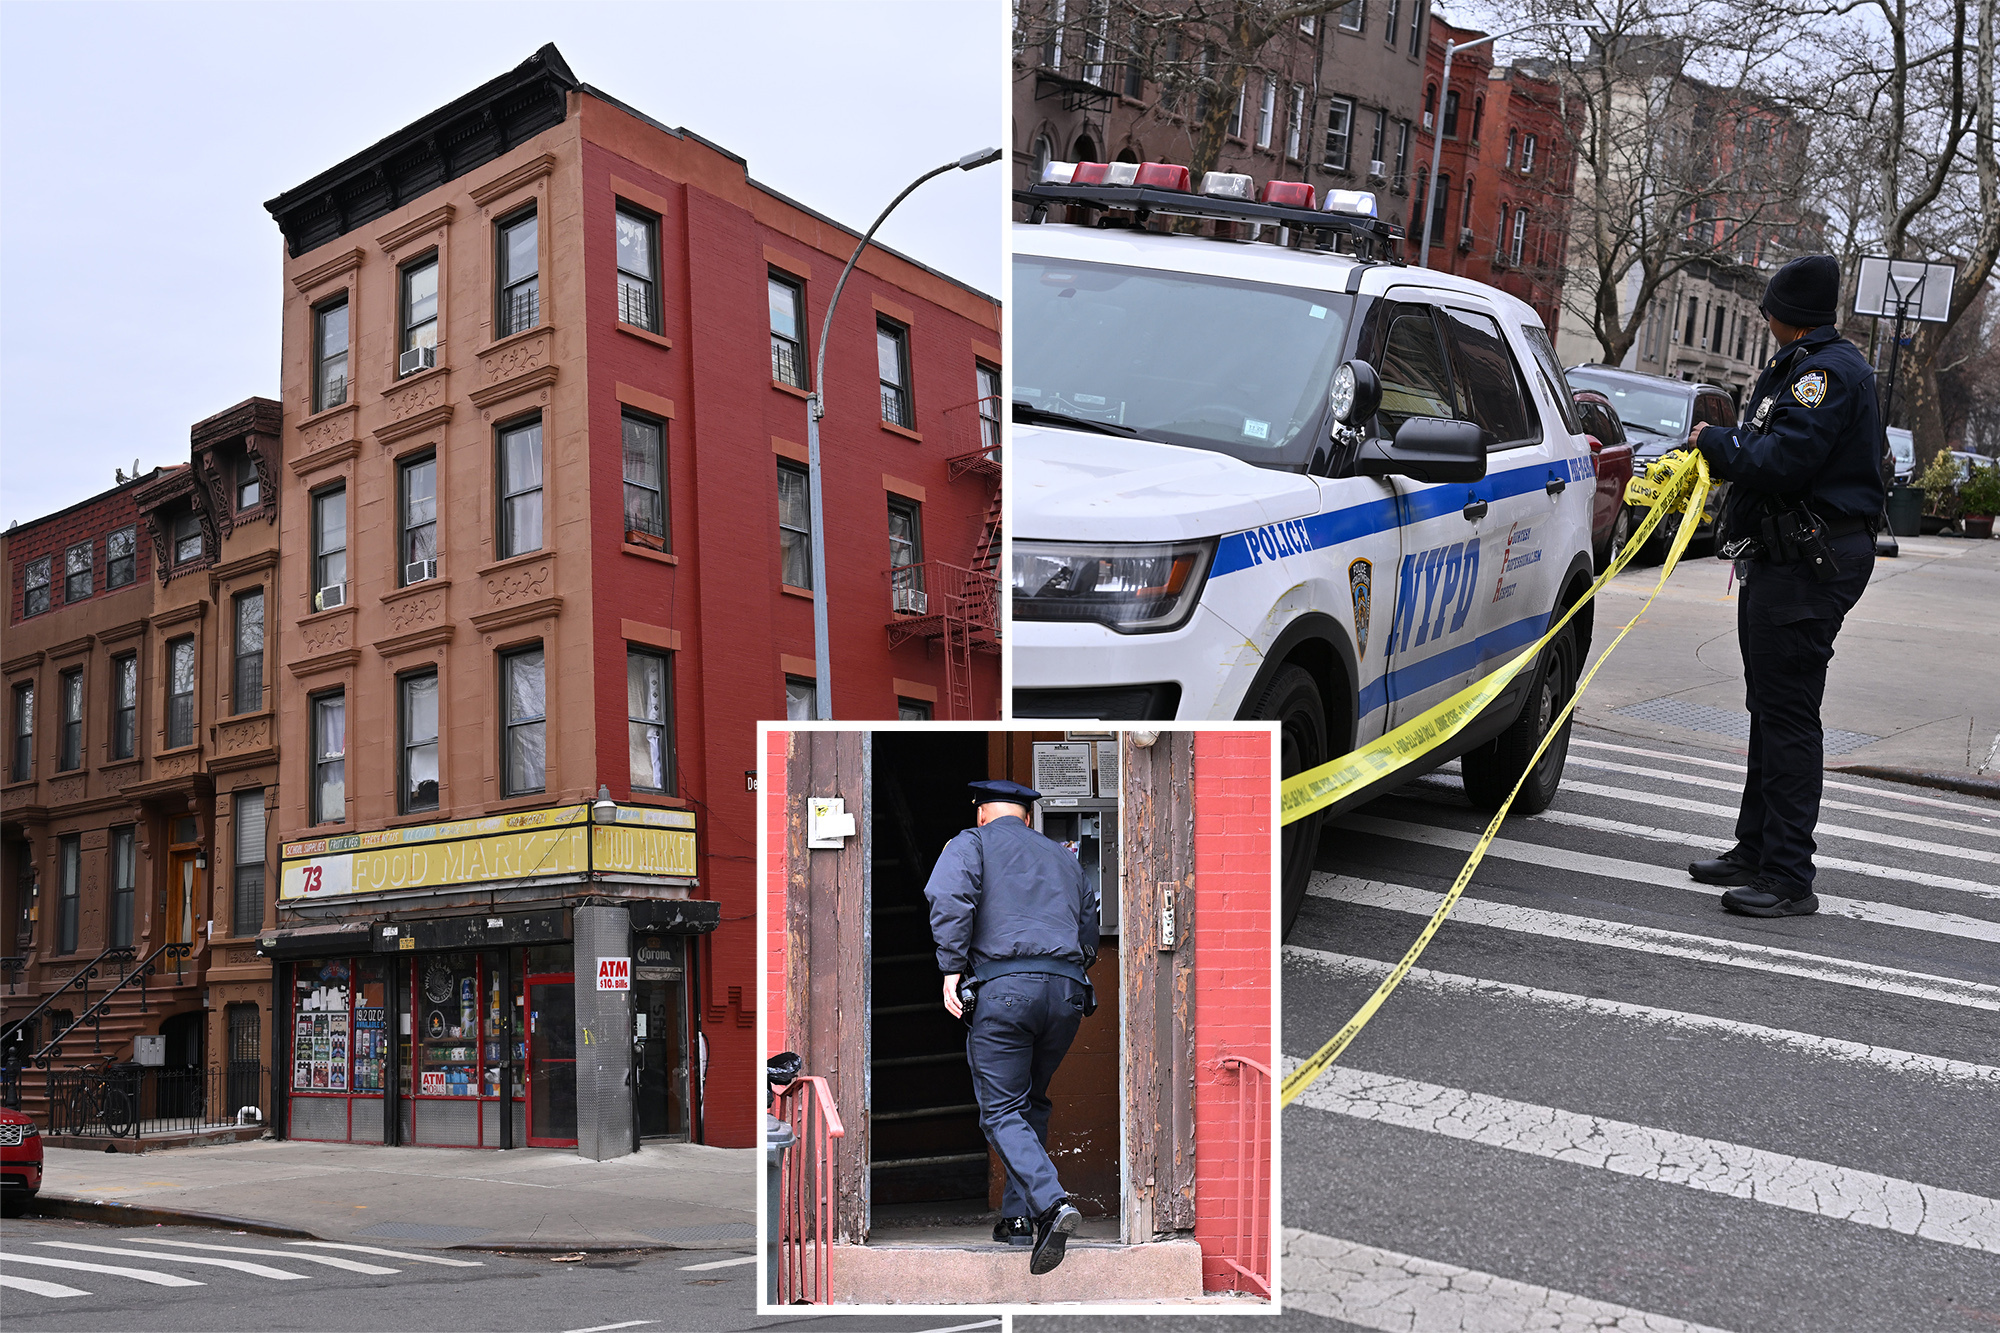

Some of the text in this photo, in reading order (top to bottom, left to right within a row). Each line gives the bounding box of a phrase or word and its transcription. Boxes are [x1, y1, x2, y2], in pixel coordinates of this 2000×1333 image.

[1245, 519, 1312, 566] POLICE
[1508, 521, 1532, 546] COURTESY
[1501, 549, 1542, 575] PROFESSIONALISM
[1384, 538, 1481, 657] NYPD
[1492, 577, 1517, 603] RESPECT
[286, 844, 303, 855] SCHOOL
[303, 841, 326, 853] SUPPLIES
[329, 839, 343, 850] FRUIT
[349, 837, 360, 847] VEG.
[363, 834, 380, 845] FRESH
[381, 832, 400, 843] MEATS
[594, 828, 695, 873] FOOD MARKET
[352, 831, 583, 890] FOOD MARKET
[302, 866, 323, 893] 73
[637, 946, 672, 963] Corona
[322, 965, 349, 977] VICTORY
[425, 962, 451, 990] WHITE CLAW
[599, 961, 629, 977] ATM
[600, 979, 628, 989] $10. Bills
[356, 1021, 380, 1029] AVAILABLE
[368, 1009, 377, 1021] OZ
[423, 1073, 444, 1085] ATM
